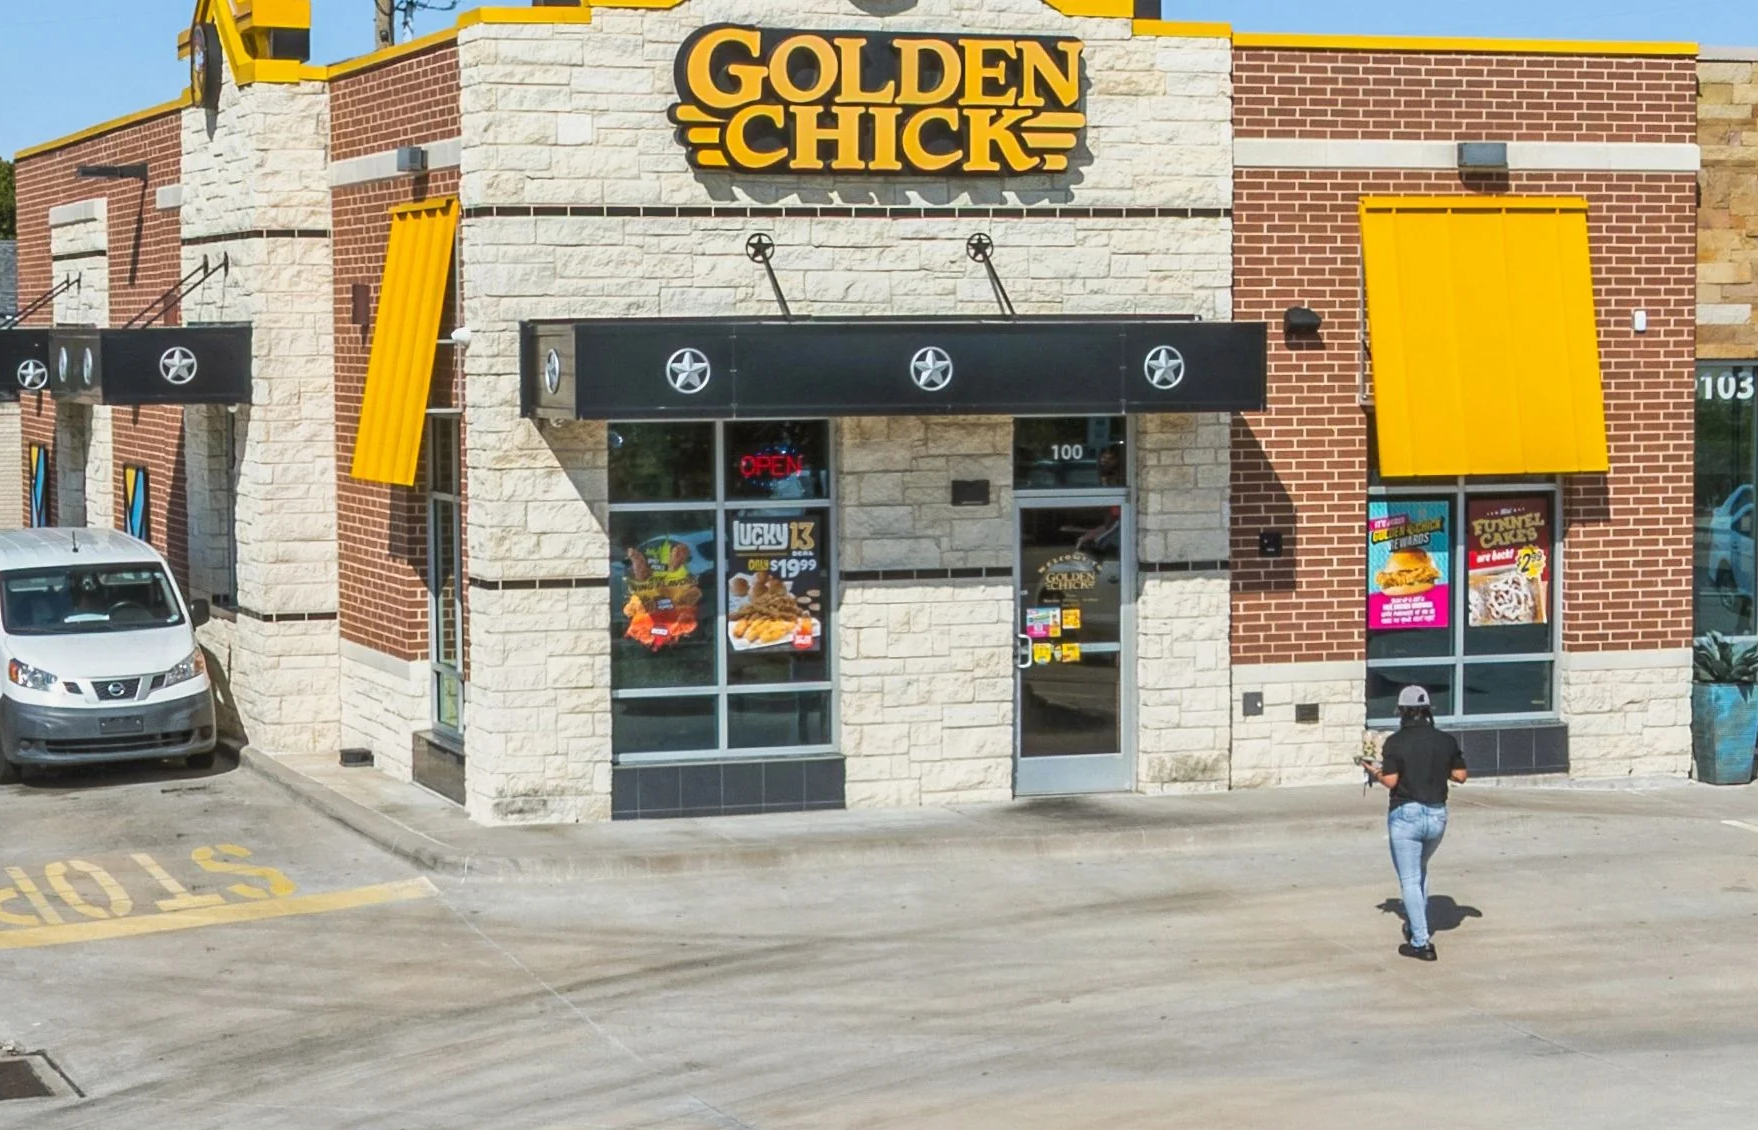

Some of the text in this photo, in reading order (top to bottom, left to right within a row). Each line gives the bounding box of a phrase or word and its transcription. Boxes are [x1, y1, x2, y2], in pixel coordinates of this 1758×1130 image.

[686, 27, 1085, 109] GOLDEN
[725, 104, 1041, 172] CHICK
[1051, 444, 1083, 460] 100
[741, 455, 803, 477] OPEN
[1472, 512, 1545, 536] FUNNEL
[733, 520, 815, 551] LUCKY 13
[1479, 527, 1538, 549] CAKES
[1046, 571, 1096, 584] GOLDEN
[1050, 580, 1090, 591] CHICK
